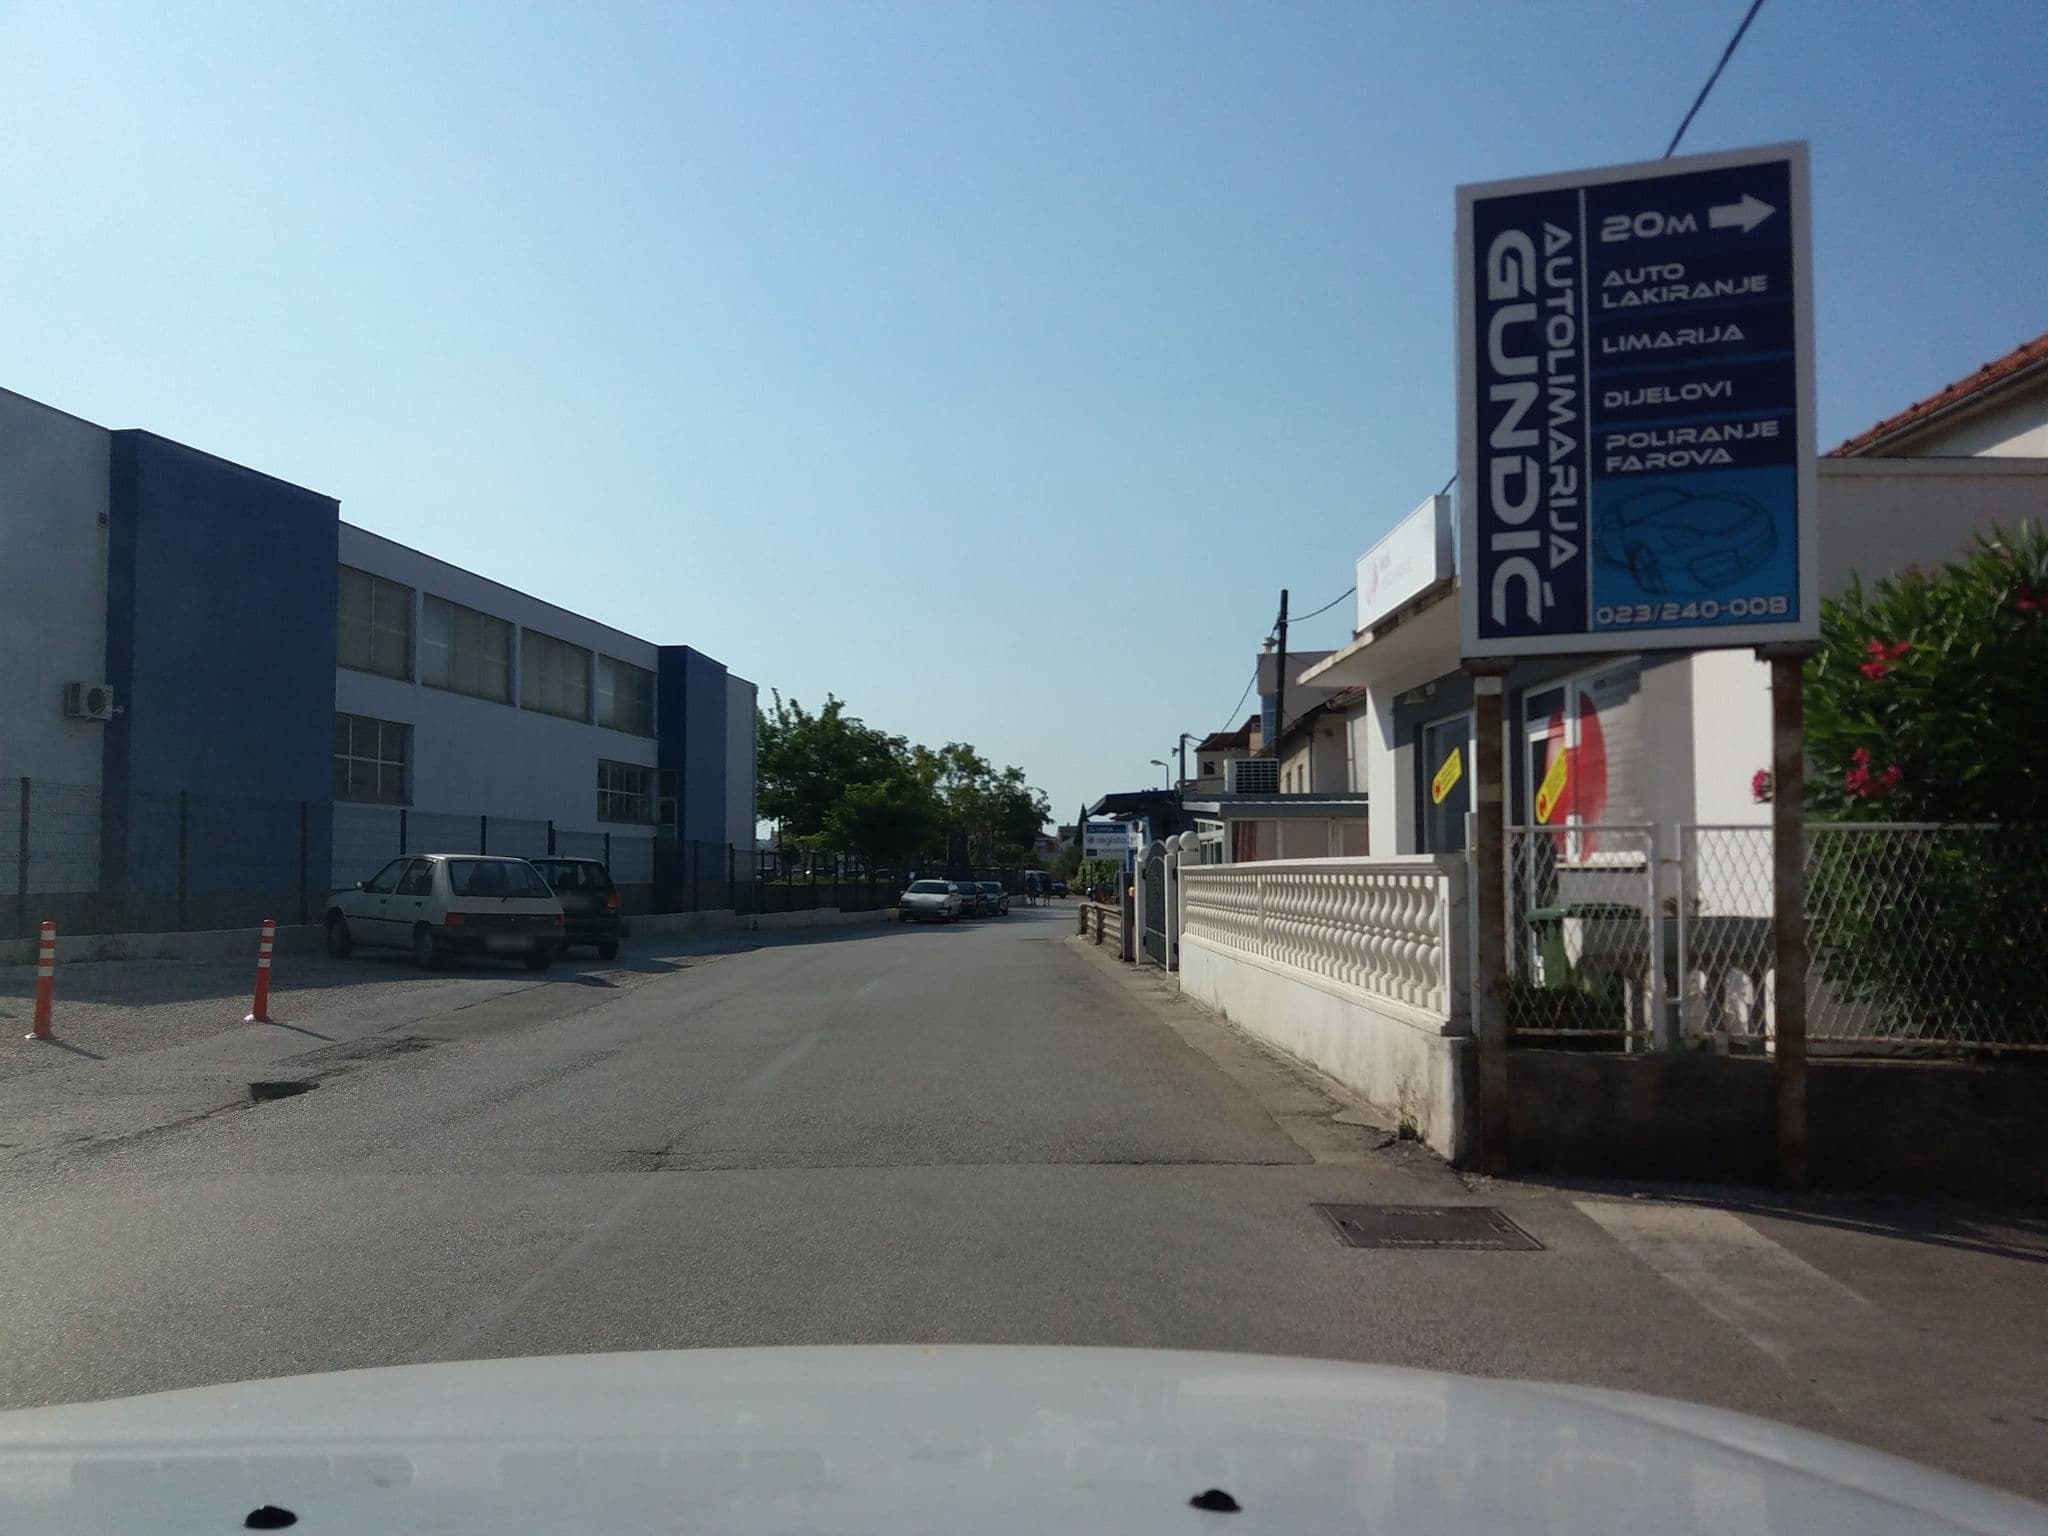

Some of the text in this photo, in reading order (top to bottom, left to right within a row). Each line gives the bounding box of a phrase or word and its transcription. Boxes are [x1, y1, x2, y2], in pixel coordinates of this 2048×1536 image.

[1602, 262, 1685, 287] AUTO
[1602, 275, 1768, 309] LAKIRANJE
[1602, 323, 1745, 353] LIMARIJA
[1543, 221, 1578, 569] AUTOLIMARIJA
[1603, 380, 1733, 408] DIJELOVI
[1487, 228, 1555, 627] GUNDIĆ
[1606, 420, 1780, 450] POLIRANJE
[1605, 447, 1733, 473] FAROVA
